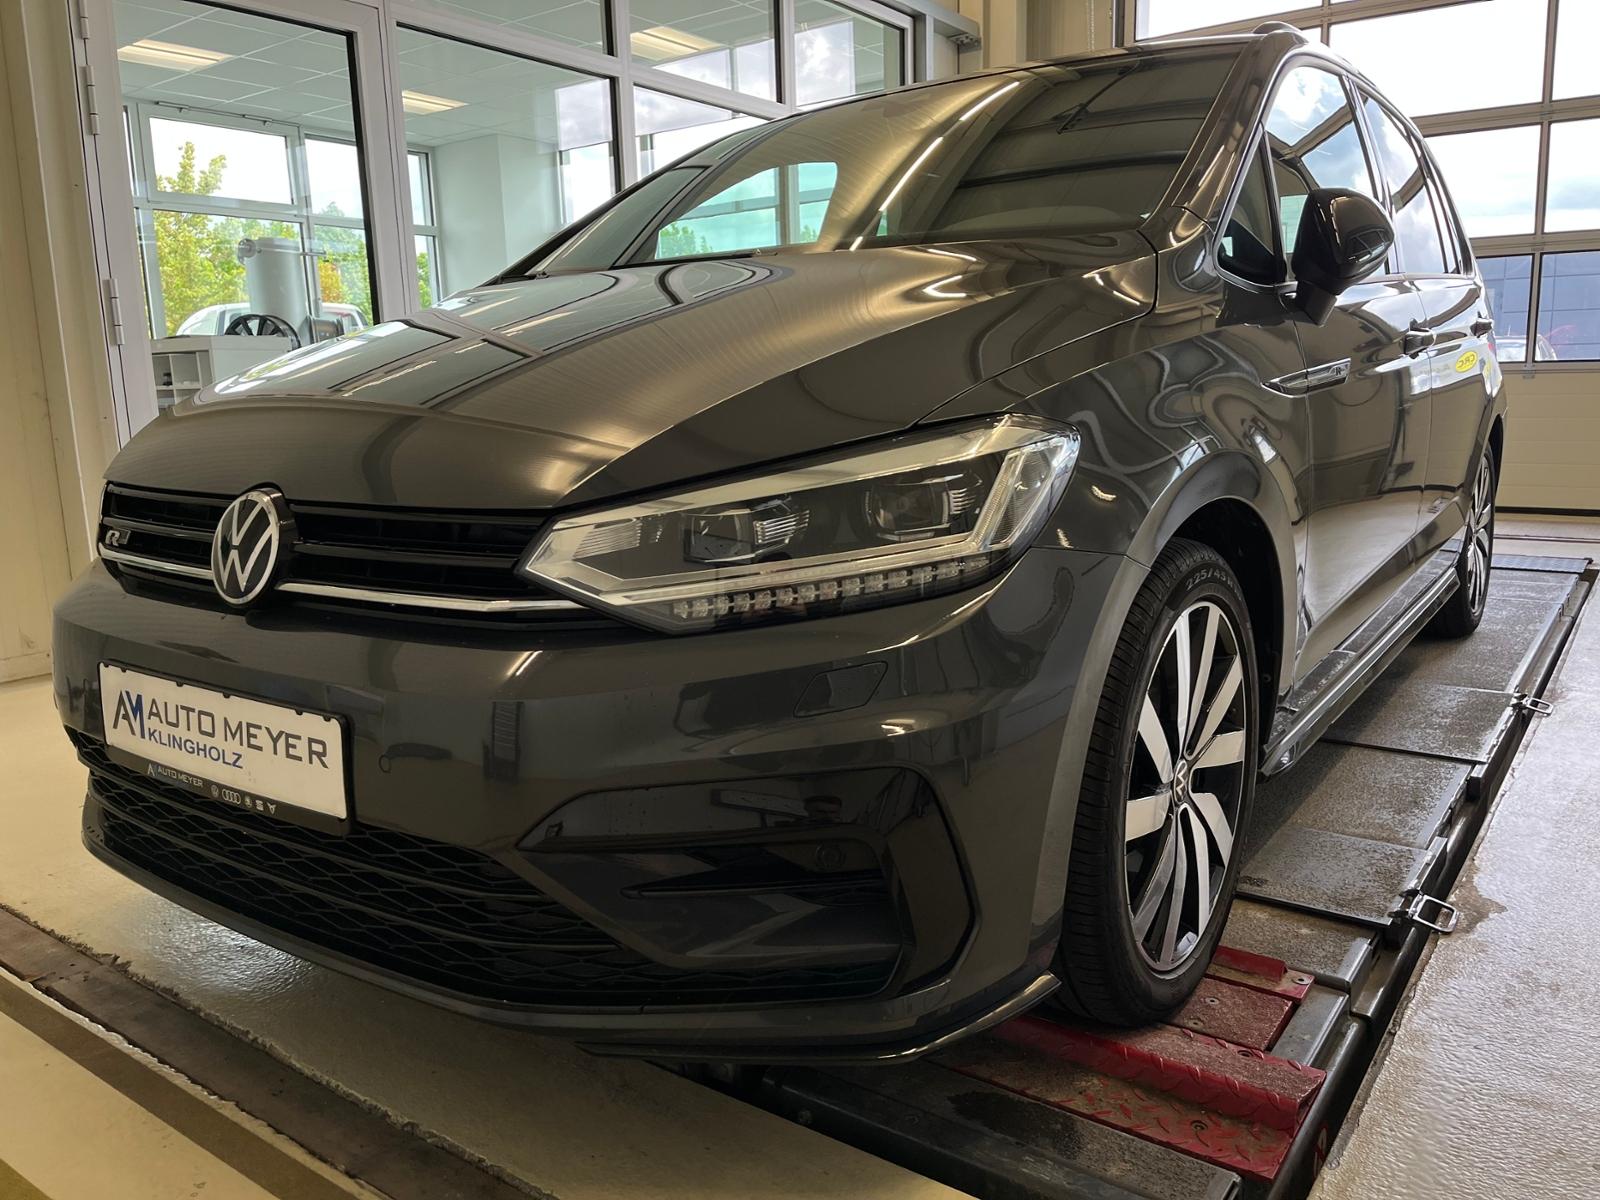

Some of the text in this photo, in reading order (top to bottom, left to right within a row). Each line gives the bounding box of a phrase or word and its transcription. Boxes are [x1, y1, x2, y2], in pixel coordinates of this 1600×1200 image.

[105, 530, 119, 546] R
[147, 698, 216, 738] AUTO
[223, 716, 329, 769] MEYER
[147, 727, 243, 769] KLINGHOLZ
[157, 765, 177, 779] AUTO
[177, 772, 204, 788] MEYER
